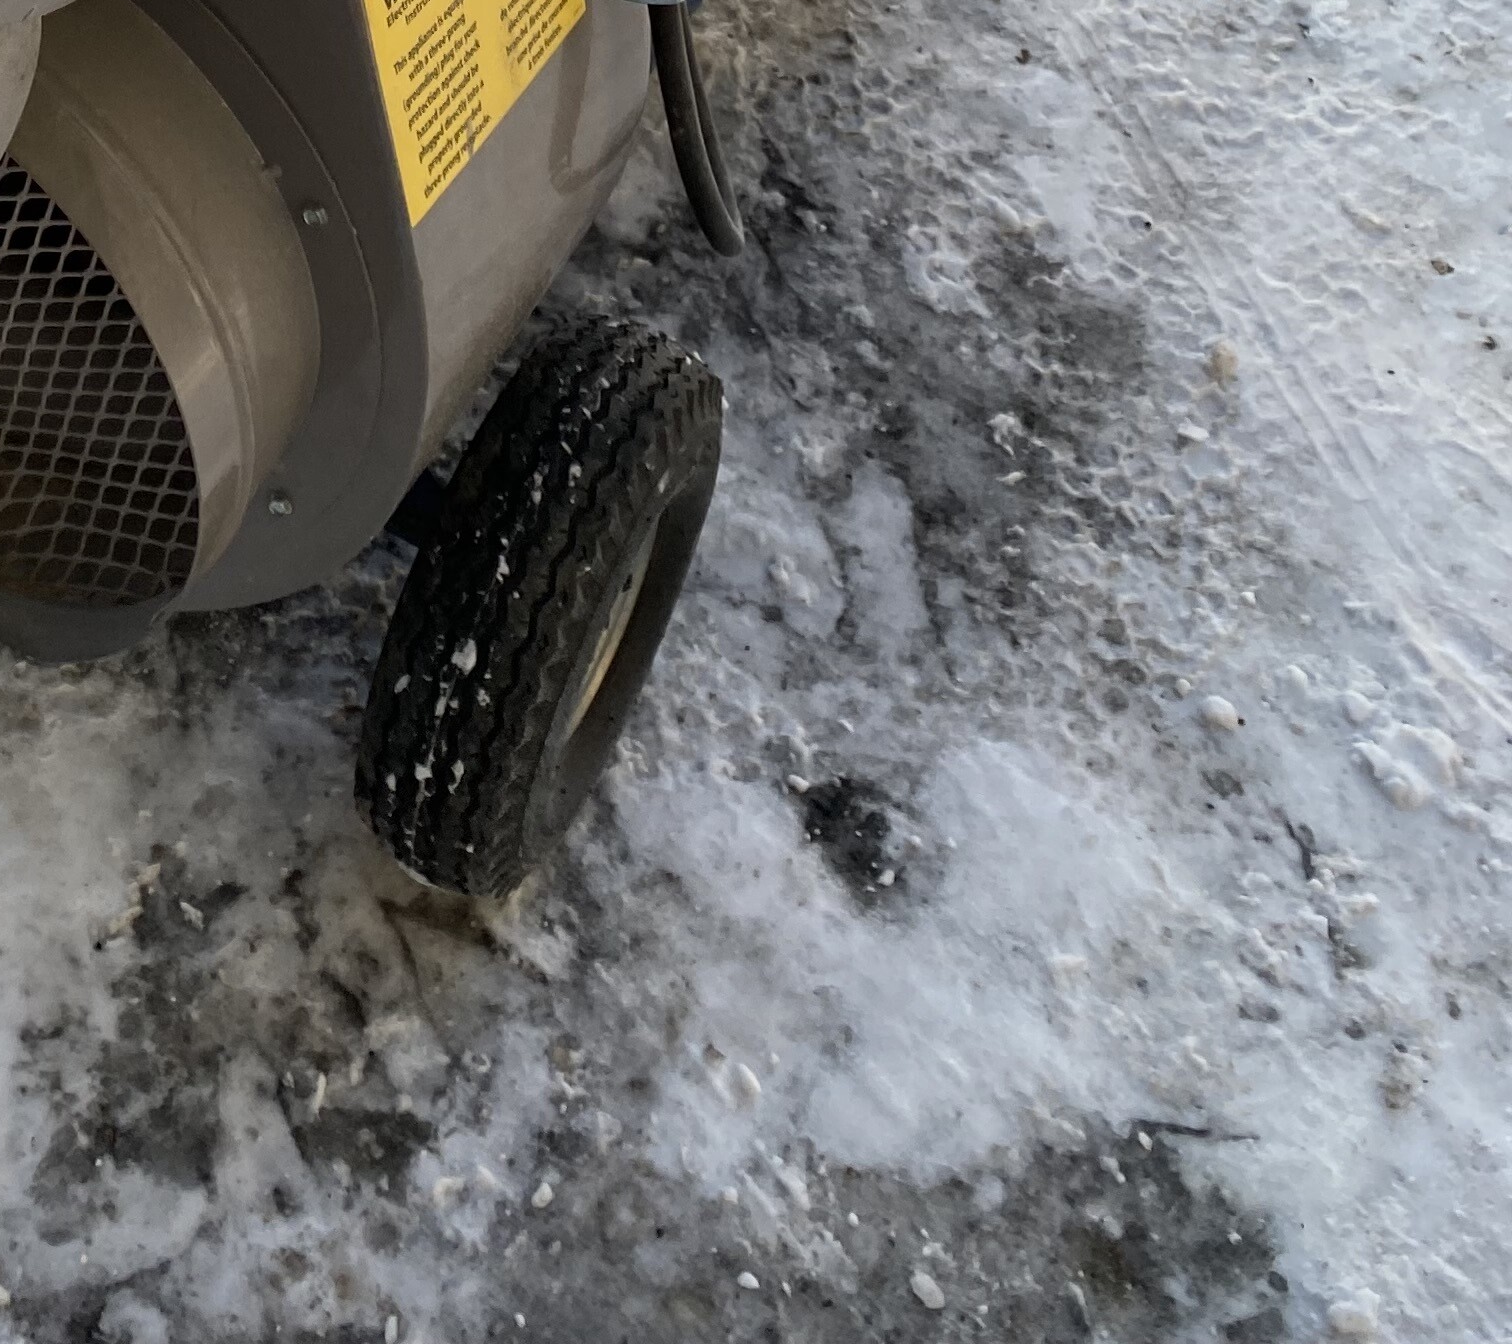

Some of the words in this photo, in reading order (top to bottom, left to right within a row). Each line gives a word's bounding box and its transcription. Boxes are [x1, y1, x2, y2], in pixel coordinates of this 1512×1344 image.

[393, 52, 407, 77] This
[406, 18, 438, 64] appliance
[408, 56, 424, 83] with
[439, 43, 455, 71] plug
[453, 33, 463, 53] for
[407, 82, 441, 132] protection
[415, 106, 438, 143] hazard
[437, 92, 451, 116] and
[449, 67, 471, 101] should
[417, 121, 445, 165] plugged
[443, 94, 467, 133] directly
[426, 133, 453, 176] properly
